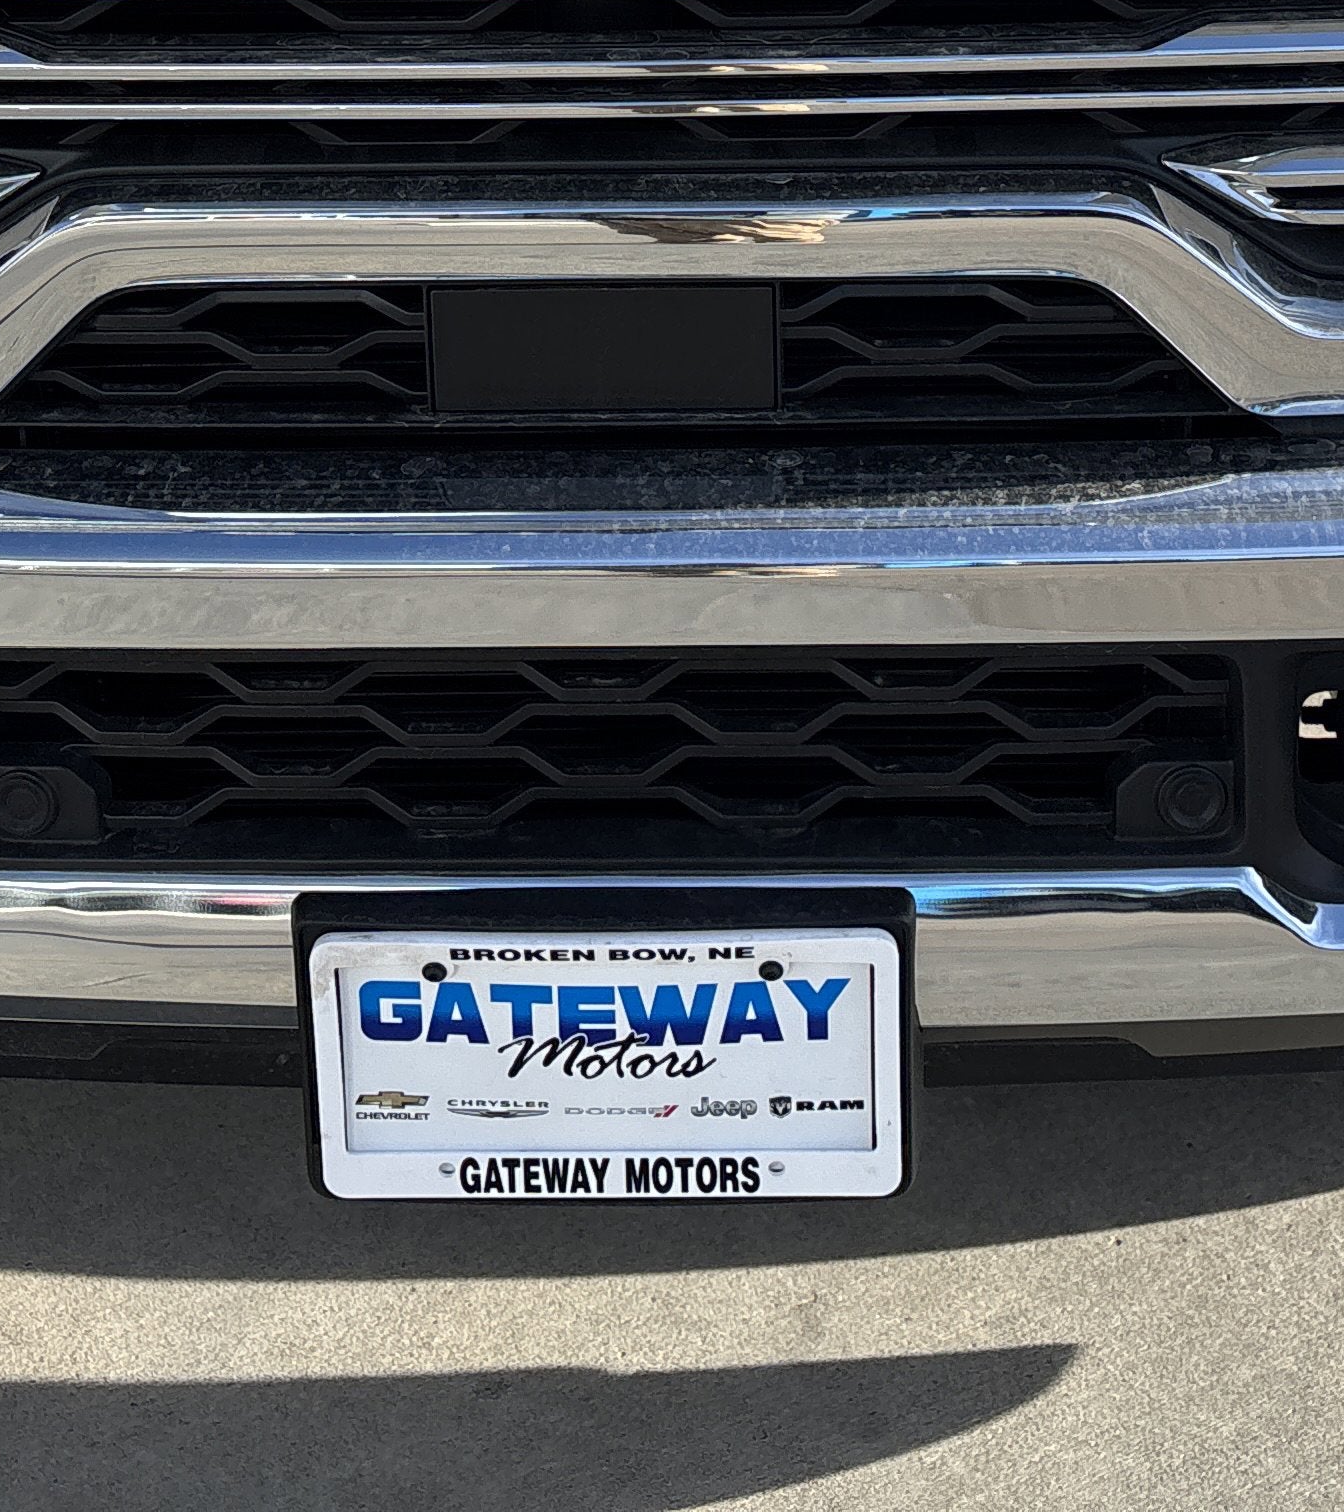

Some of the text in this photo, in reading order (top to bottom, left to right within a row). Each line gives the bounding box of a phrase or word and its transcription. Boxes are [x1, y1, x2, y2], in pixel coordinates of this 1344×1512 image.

[450, 946, 756, 964] BROKEN BOW, NE
[358, 977, 852, 1047] GATEWAY
[499, 1031, 717, 1080] Motors
[355, 1096, 865, 1120] CHEVROLET CHRYSLER DODGE Jeep RAM
[460, 1157, 761, 1194] GATEWAY MOTORS
